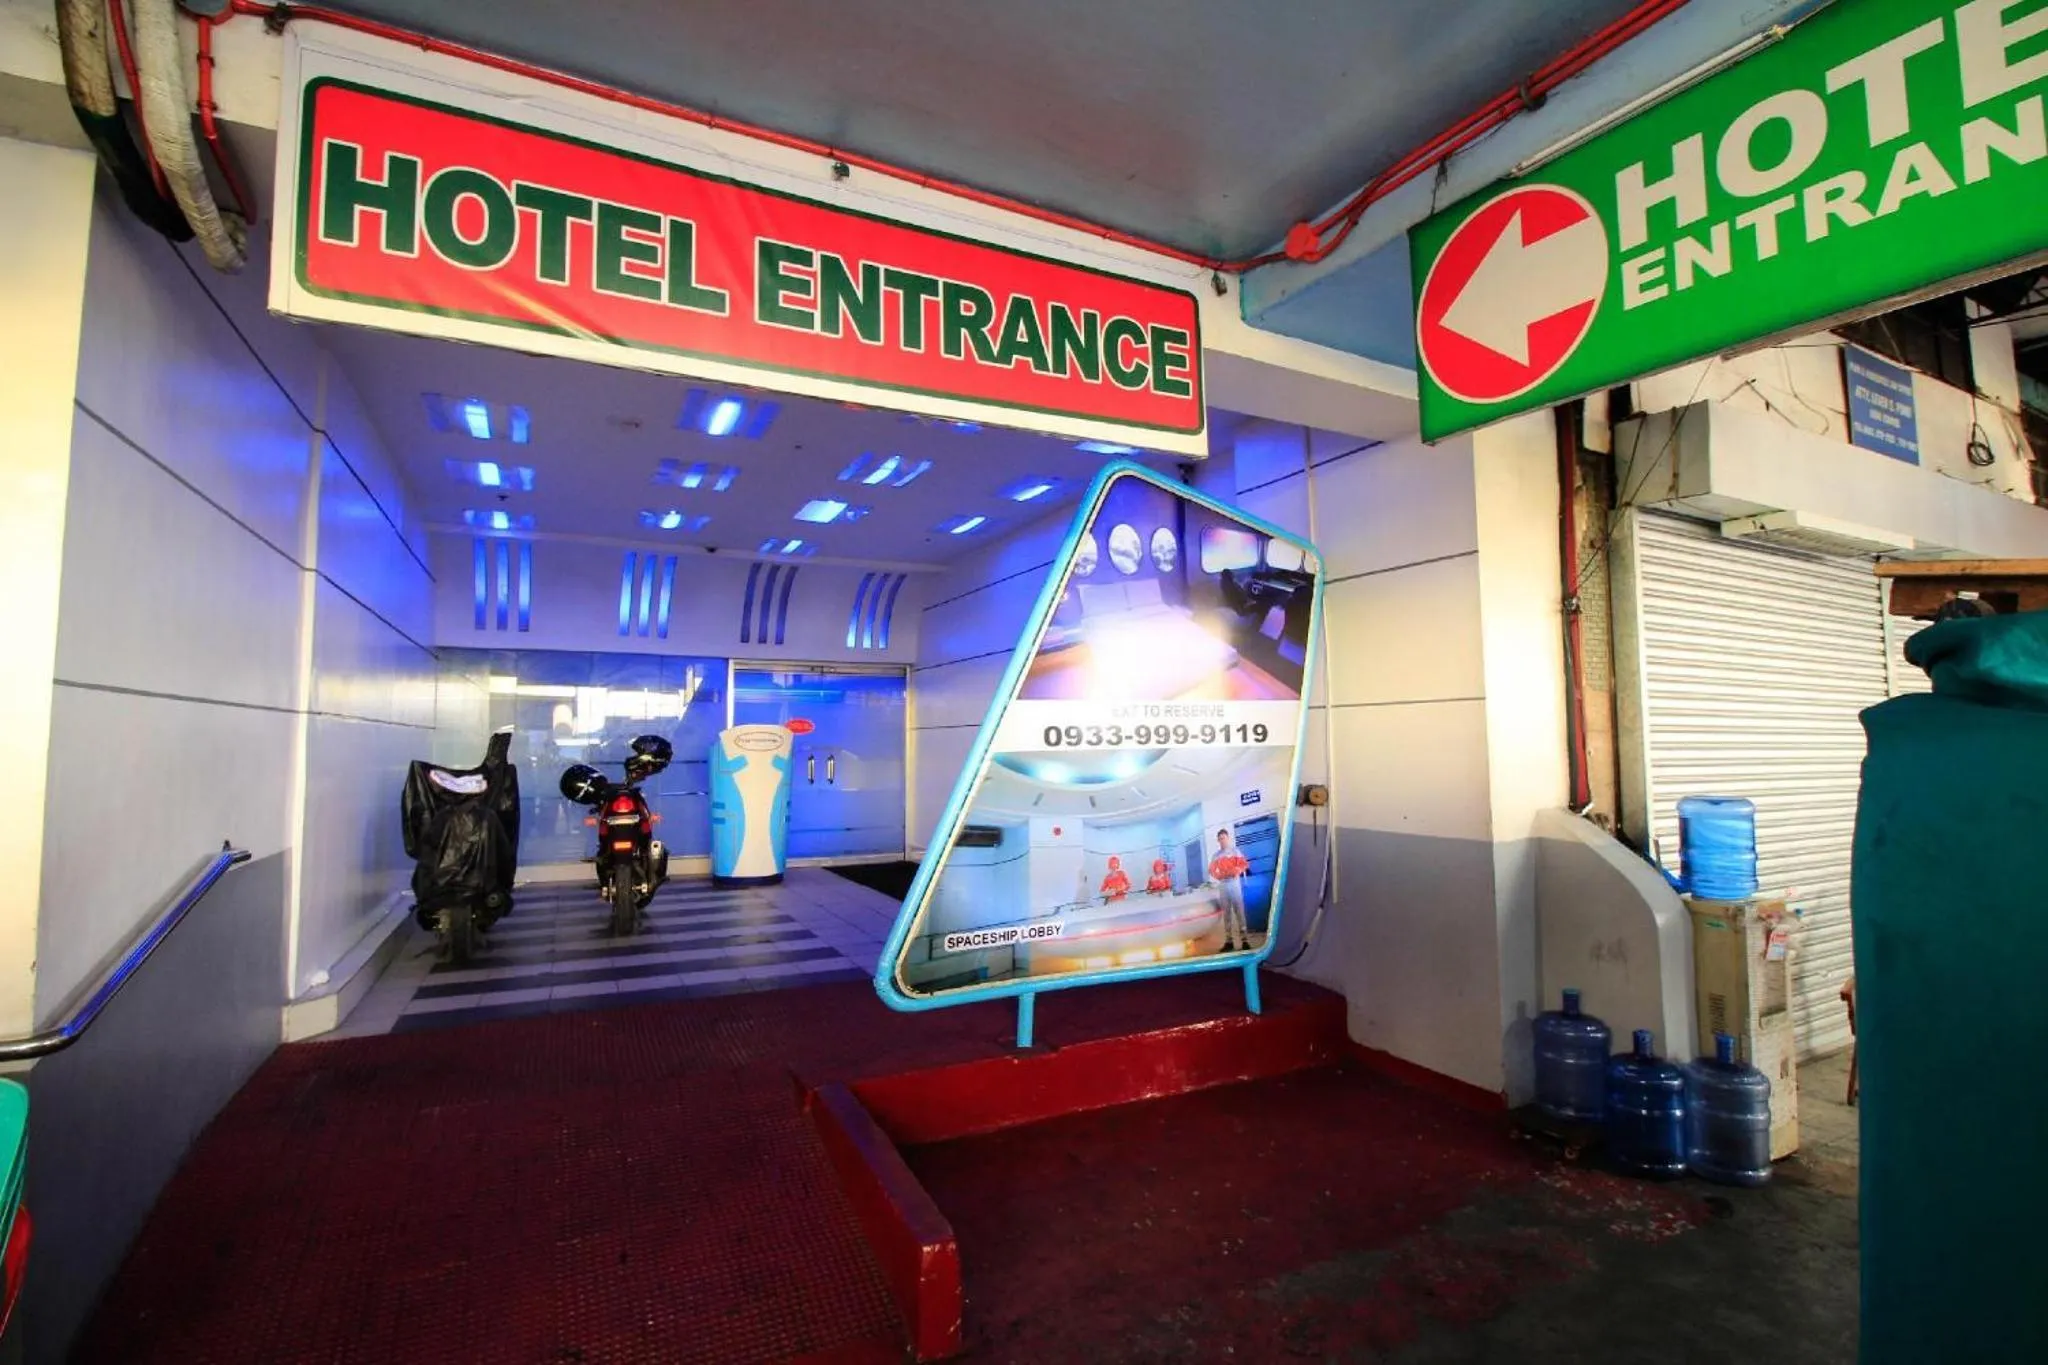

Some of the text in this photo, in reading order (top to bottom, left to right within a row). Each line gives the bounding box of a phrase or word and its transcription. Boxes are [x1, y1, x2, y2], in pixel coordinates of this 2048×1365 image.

[1621, 94, 2048, 311] ENTRAN
[319, 138, 1192, 398] HOTEL ENTRANCE
[1143, 705, 1160, 718] TO
[1163, 704, 1225, 717] RESERVE
[1043, 724, 1268, 747] 0933-999-9119
[947, 925, 1061, 949] SPACESHIP LOBBY
